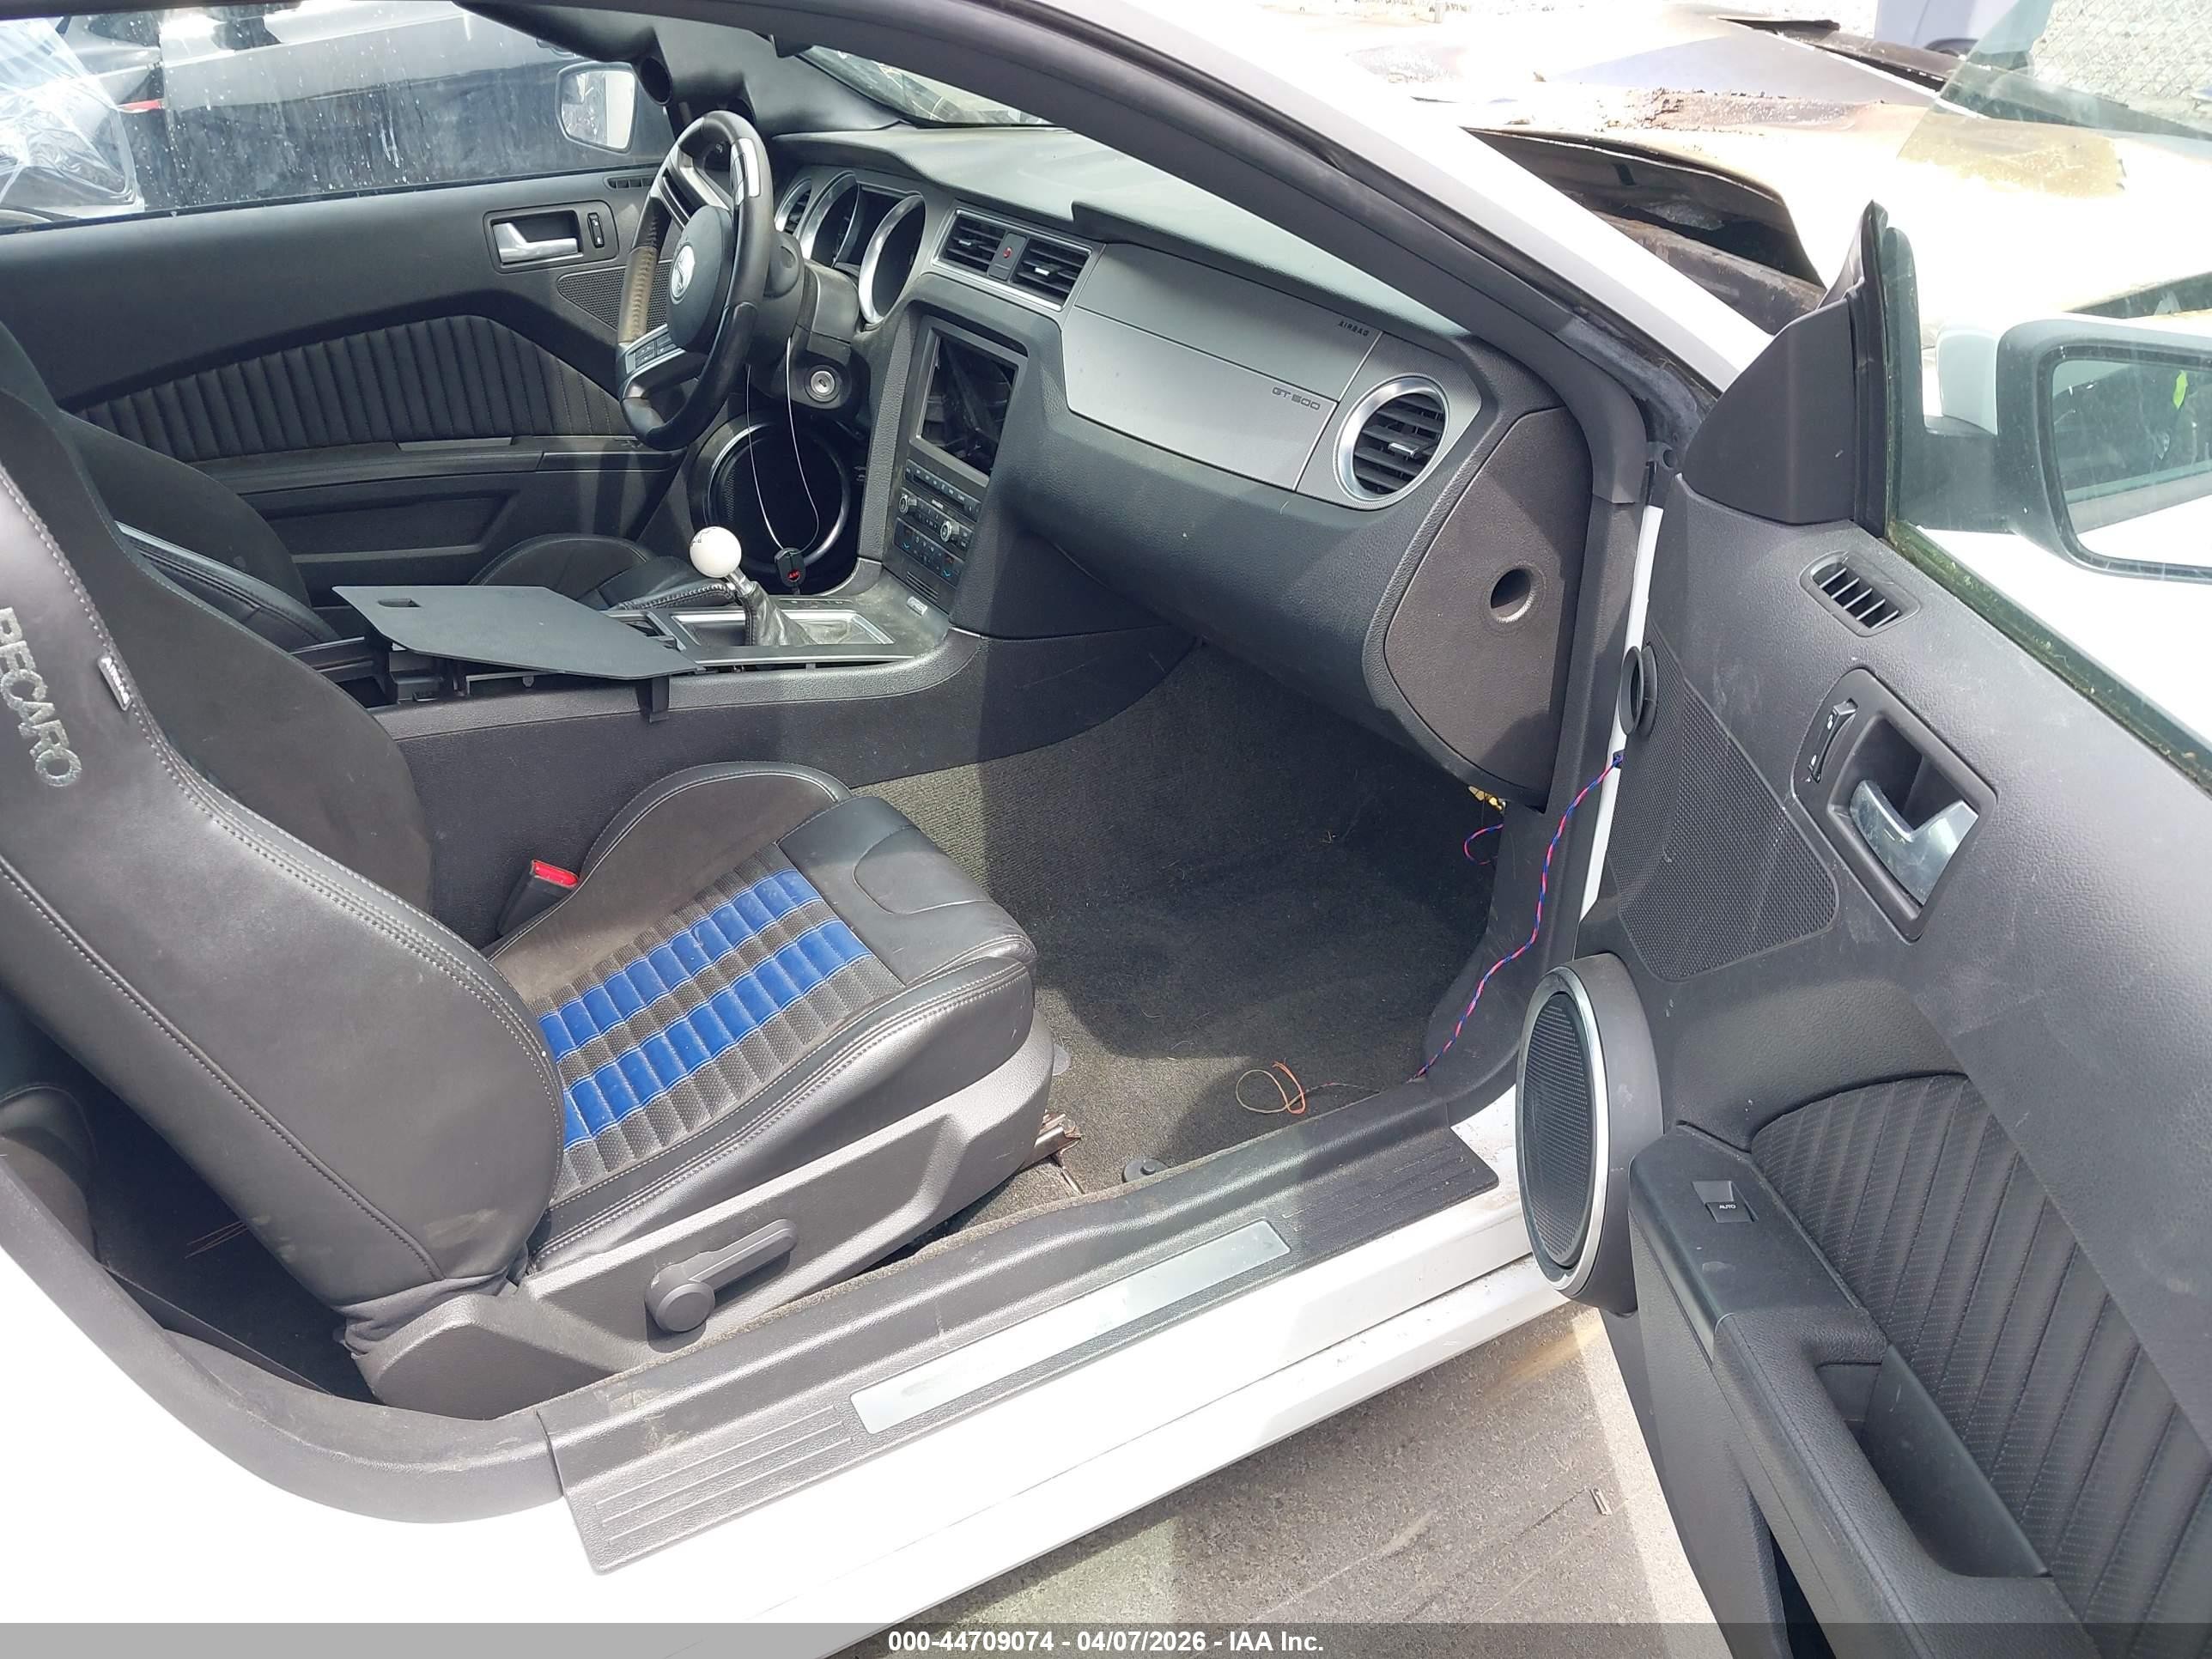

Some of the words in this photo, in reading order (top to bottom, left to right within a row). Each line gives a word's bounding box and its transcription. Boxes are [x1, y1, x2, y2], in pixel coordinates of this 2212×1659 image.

[1338, 320, 1370, 337] AIRBAG
[1272, 386, 1291, 398] GT
[1291, 393, 1321, 410] 500
[0, 606, 82, 787] RECARO
[100, 656, 131, 705] AIRBAG
